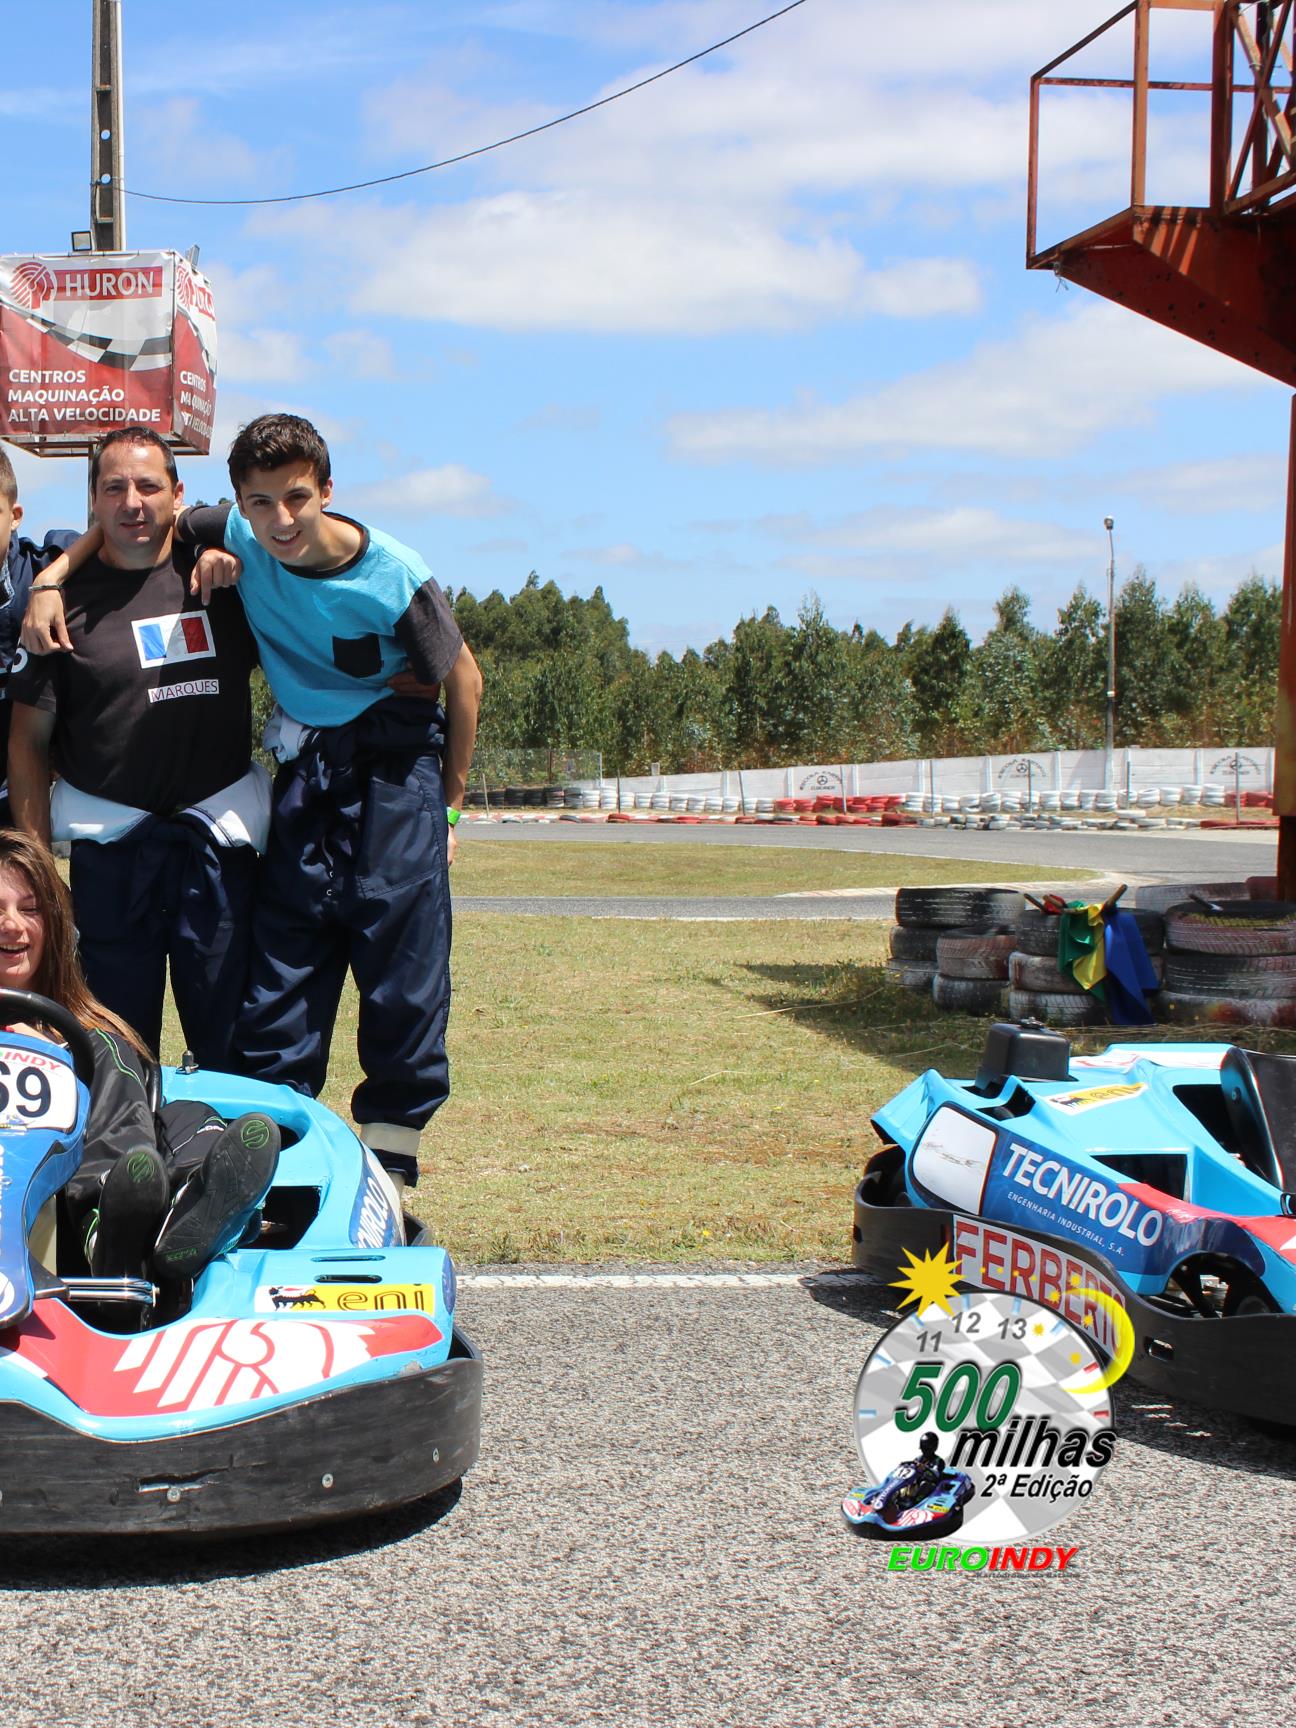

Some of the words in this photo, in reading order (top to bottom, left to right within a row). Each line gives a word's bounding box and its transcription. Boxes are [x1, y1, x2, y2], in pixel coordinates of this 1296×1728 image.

[65, 271, 154, 297] HURON
[8, 369, 86, 384] CENTROS
[8, 385, 125, 405] MAQUINAÇÃO
[8, 408, 50, 423] ALTA
[53, 407, 161, 423] VELOCIDADE
[150, 680, 219, 702] MARQUES
[1001, 1142, 1164, 1247] TECNIROLO
[1006, 1191, 1056, 1221] ENGENHARIA
[1056, 1215, 1106, 1248] INDUSTRIAL,
[1107, 1241, 1125, 1257] S.A.
[337, 1283, 425, 1311] eni
